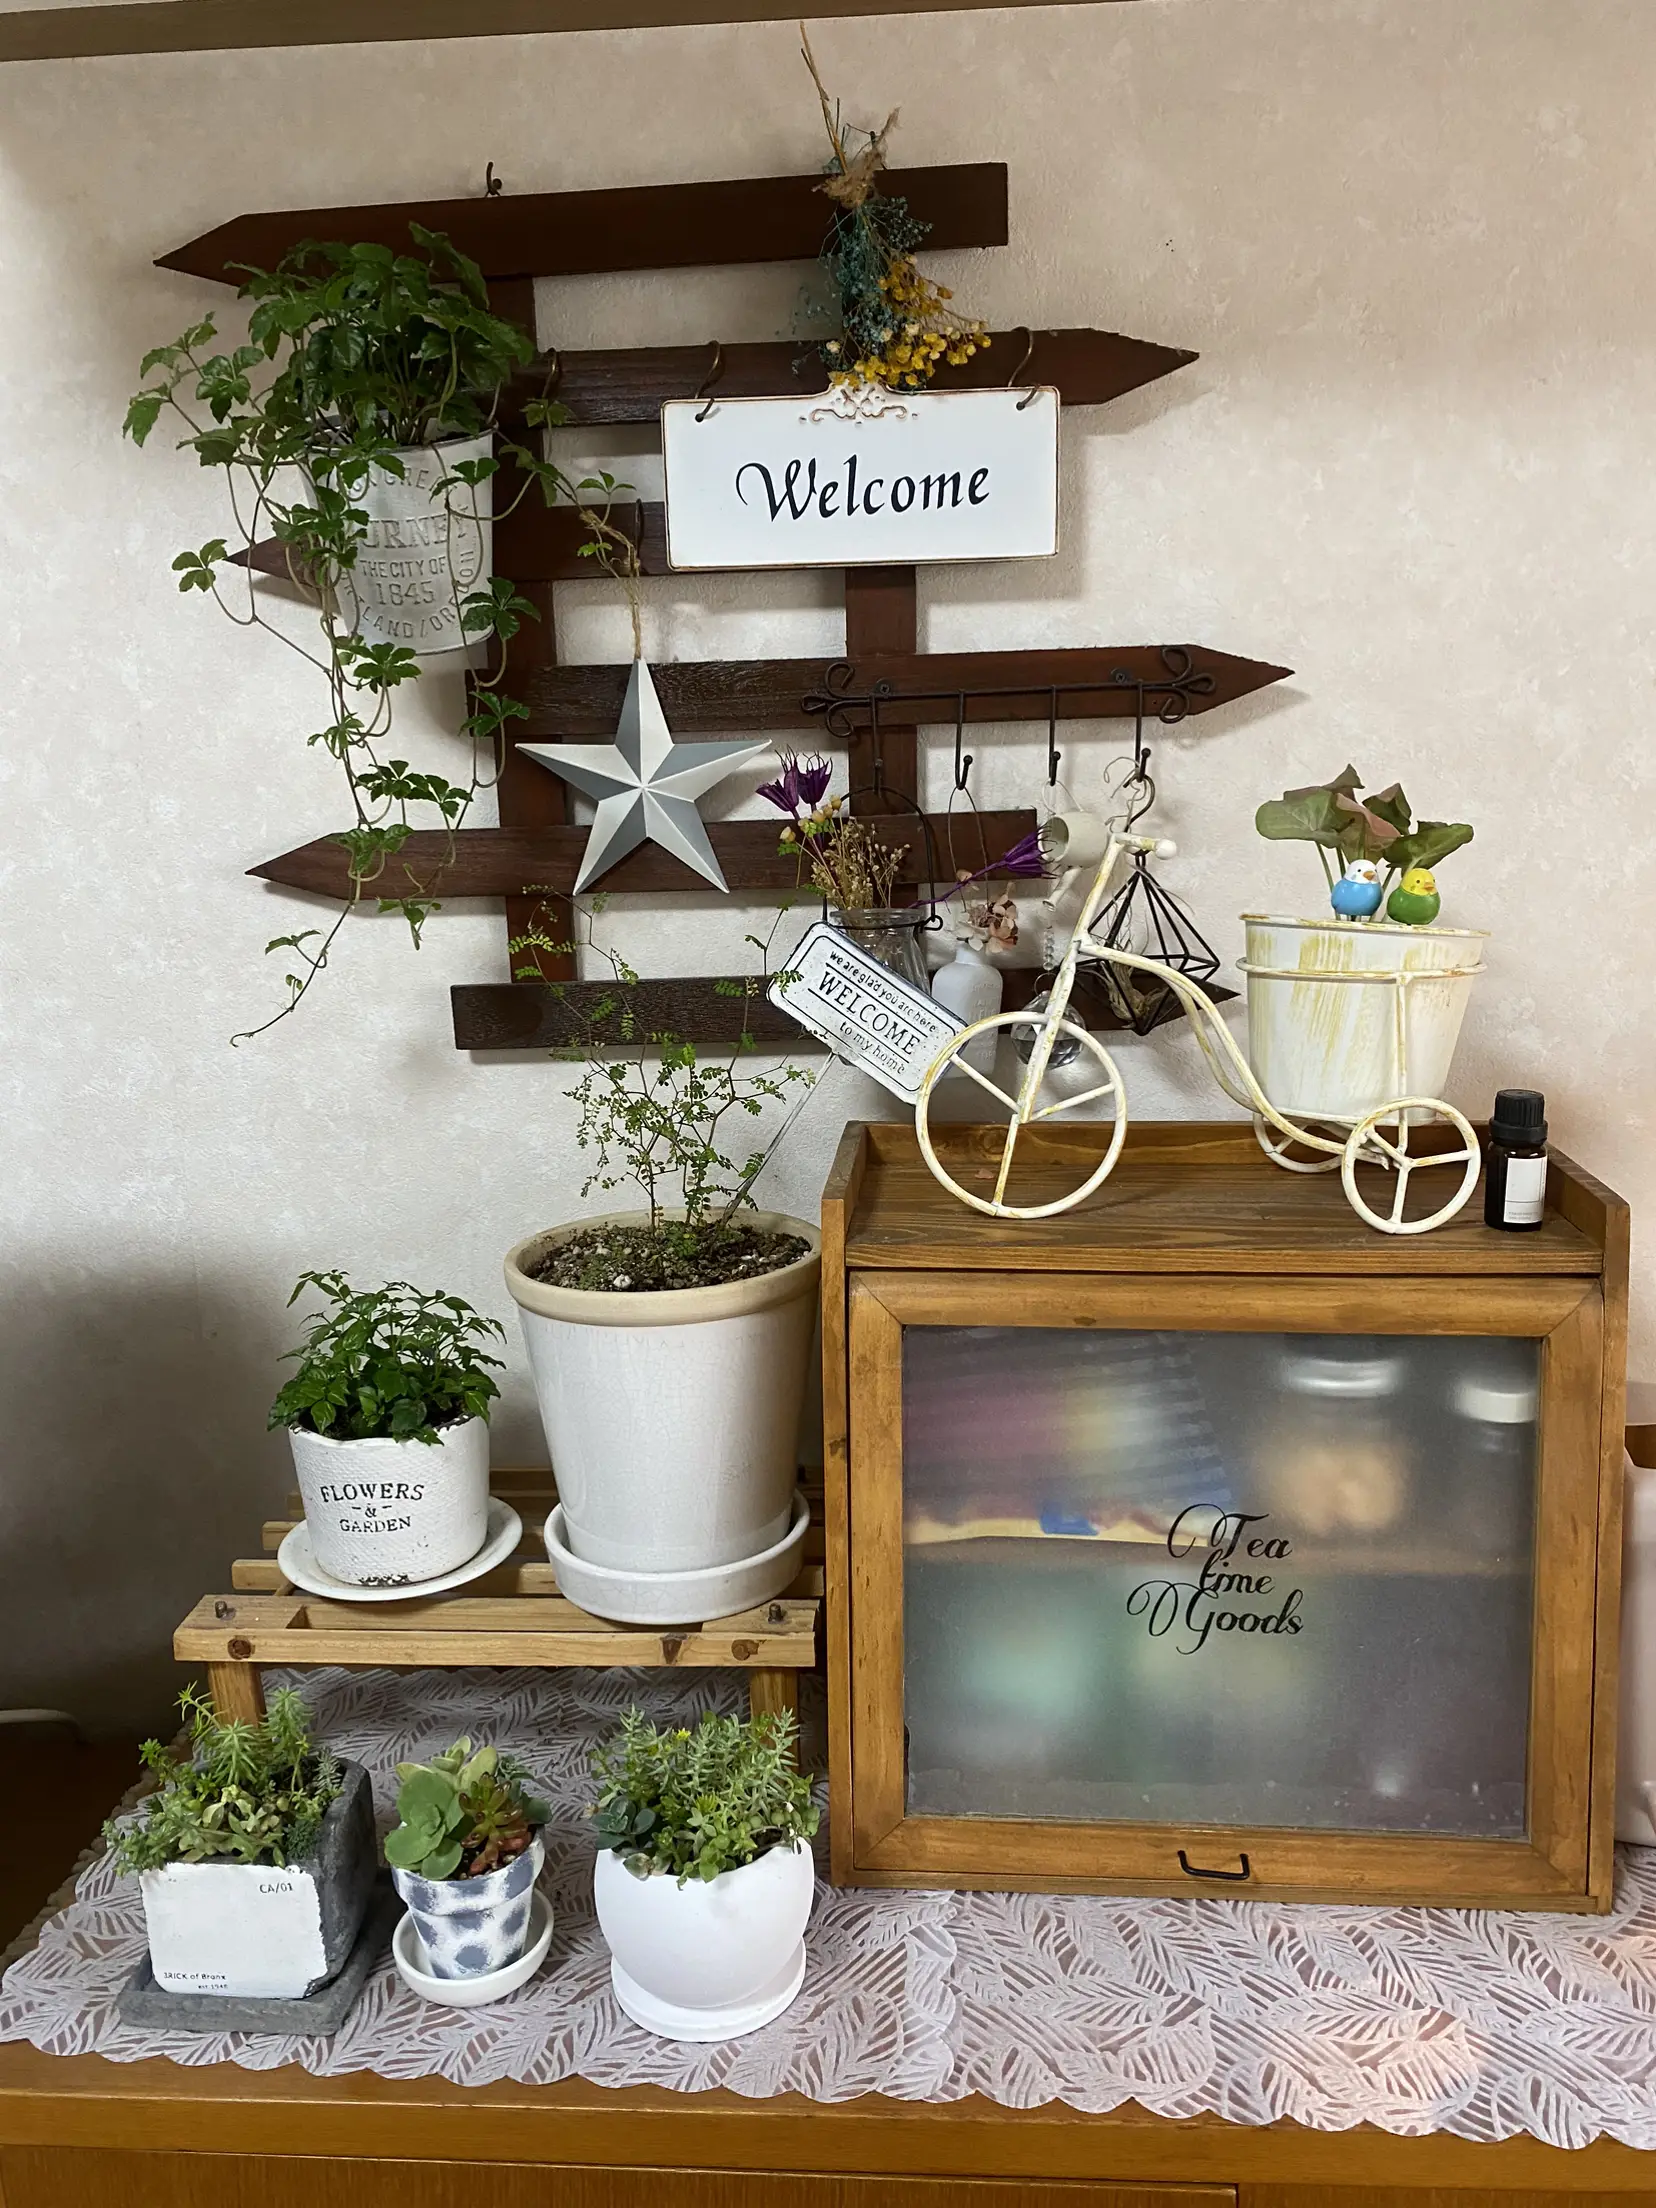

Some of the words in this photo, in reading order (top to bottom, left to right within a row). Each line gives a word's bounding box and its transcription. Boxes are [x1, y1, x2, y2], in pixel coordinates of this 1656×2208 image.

[735, 454, 990, 522] Welcome
[359, 560, 388, 578] THE
[389, 559, 424, 578] CITY
[429, 556, 446, 575] OF
[376, 580, 435, 606] 1845
[830, 950, 843, 966] we
[843, 962, 859, 977] are
[857, 972, 880, 992] glad
[878, 987, 898, 1005] you
[913, 1011, 937, 1033] here
[818, 971, 921, 1055] WELCOME
[840, 1020, 852, 1036] to
[853, 1033, 873, 1051] my
[872, 1046, 906, 1074] home
[319, 1482, 425, 1503] FLOWERS
[364, 1503, 378, 1518] &
[339, 1516, 412, 1533] GARDEN
[1167, 1503, 1292, 1561] Tea
[1199, 1548, 1275, 1594] time
[1127, 1580, 1304, 1655] Goods
[259, 1882, 293, 1894] CA/01
[190, 1972, 199, 1980] of
